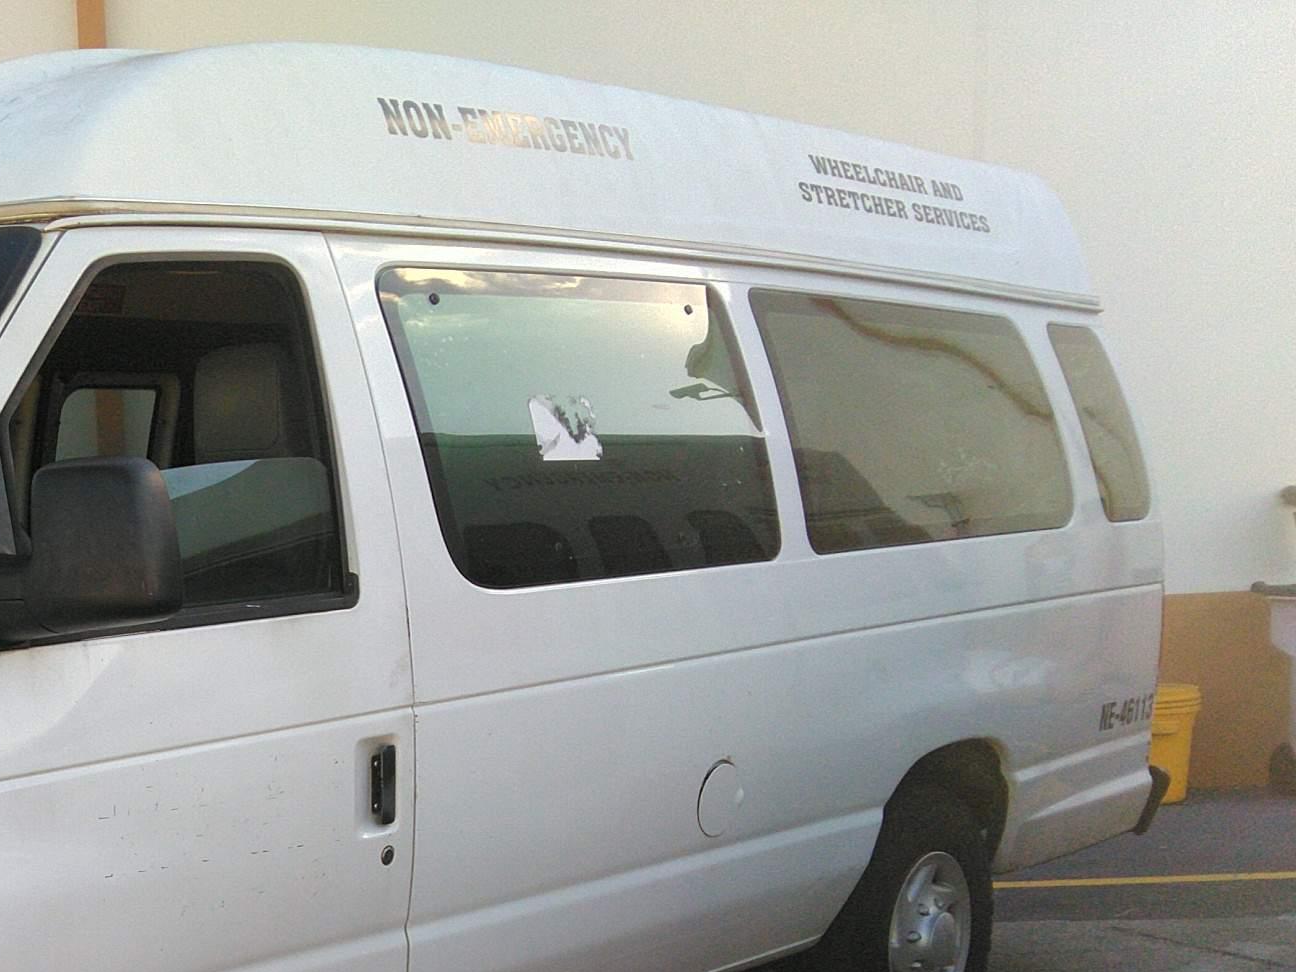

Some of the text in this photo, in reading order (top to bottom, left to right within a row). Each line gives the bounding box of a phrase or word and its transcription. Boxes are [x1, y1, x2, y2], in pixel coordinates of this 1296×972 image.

[377, 97, 635, 161] NON-EMERGENCY
[808, 154, 964, 202] WHEELCHAIR AND
[798, 181, 991, 234] STRETCHER SERVICES
